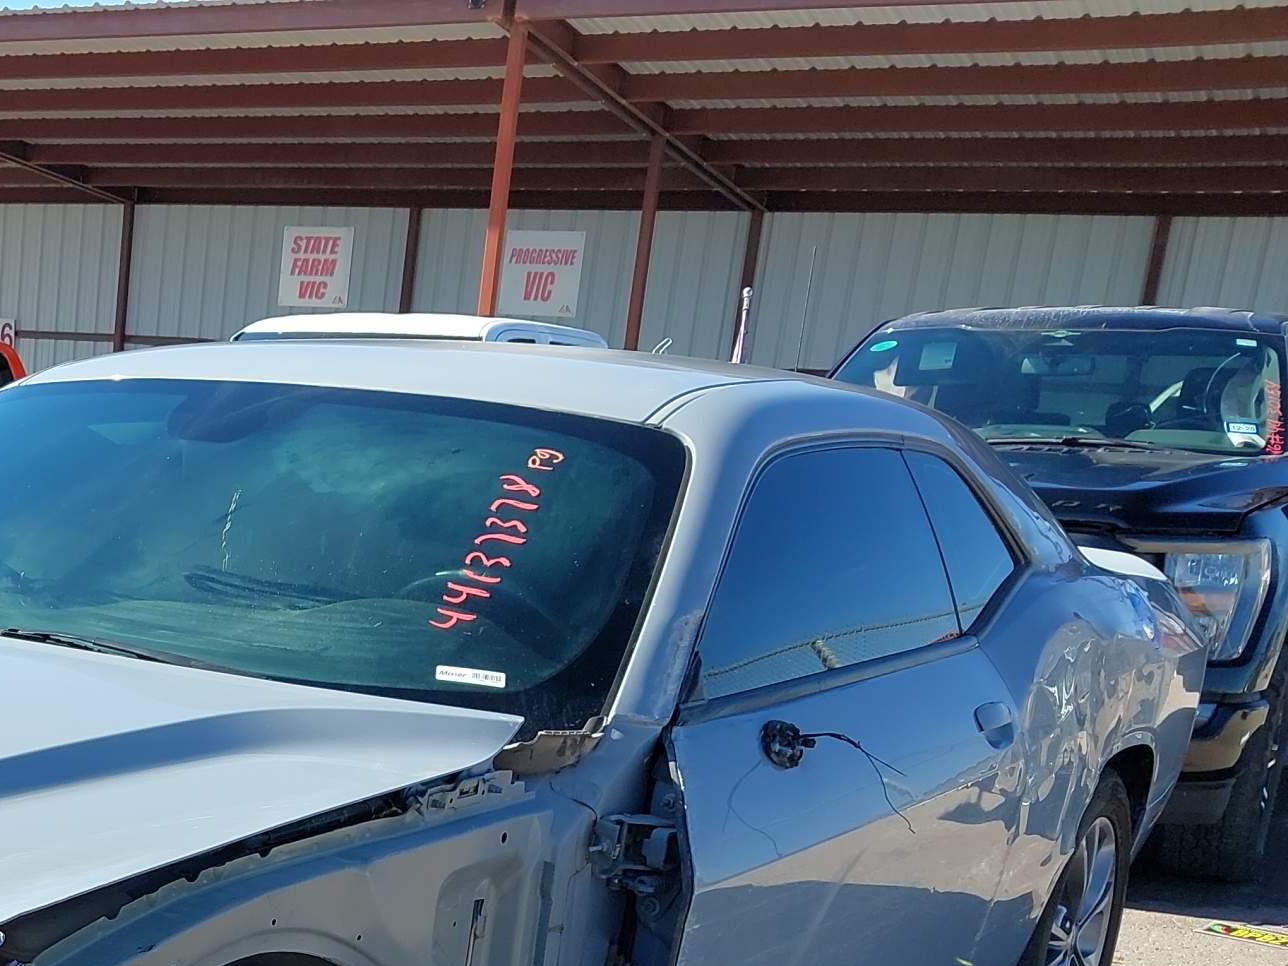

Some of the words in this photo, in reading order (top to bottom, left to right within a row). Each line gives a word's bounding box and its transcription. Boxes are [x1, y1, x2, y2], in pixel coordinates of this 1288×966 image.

[291, 235, 342, 255] STATE
[508, 247, 578, 266] PROGRESSIVE
[290, 257, 337, 277] FARM
[297, 280, 329, 300] VIC
[523, 271, 556, 302] VIC
[429, 473, 541, 631] 44137378
